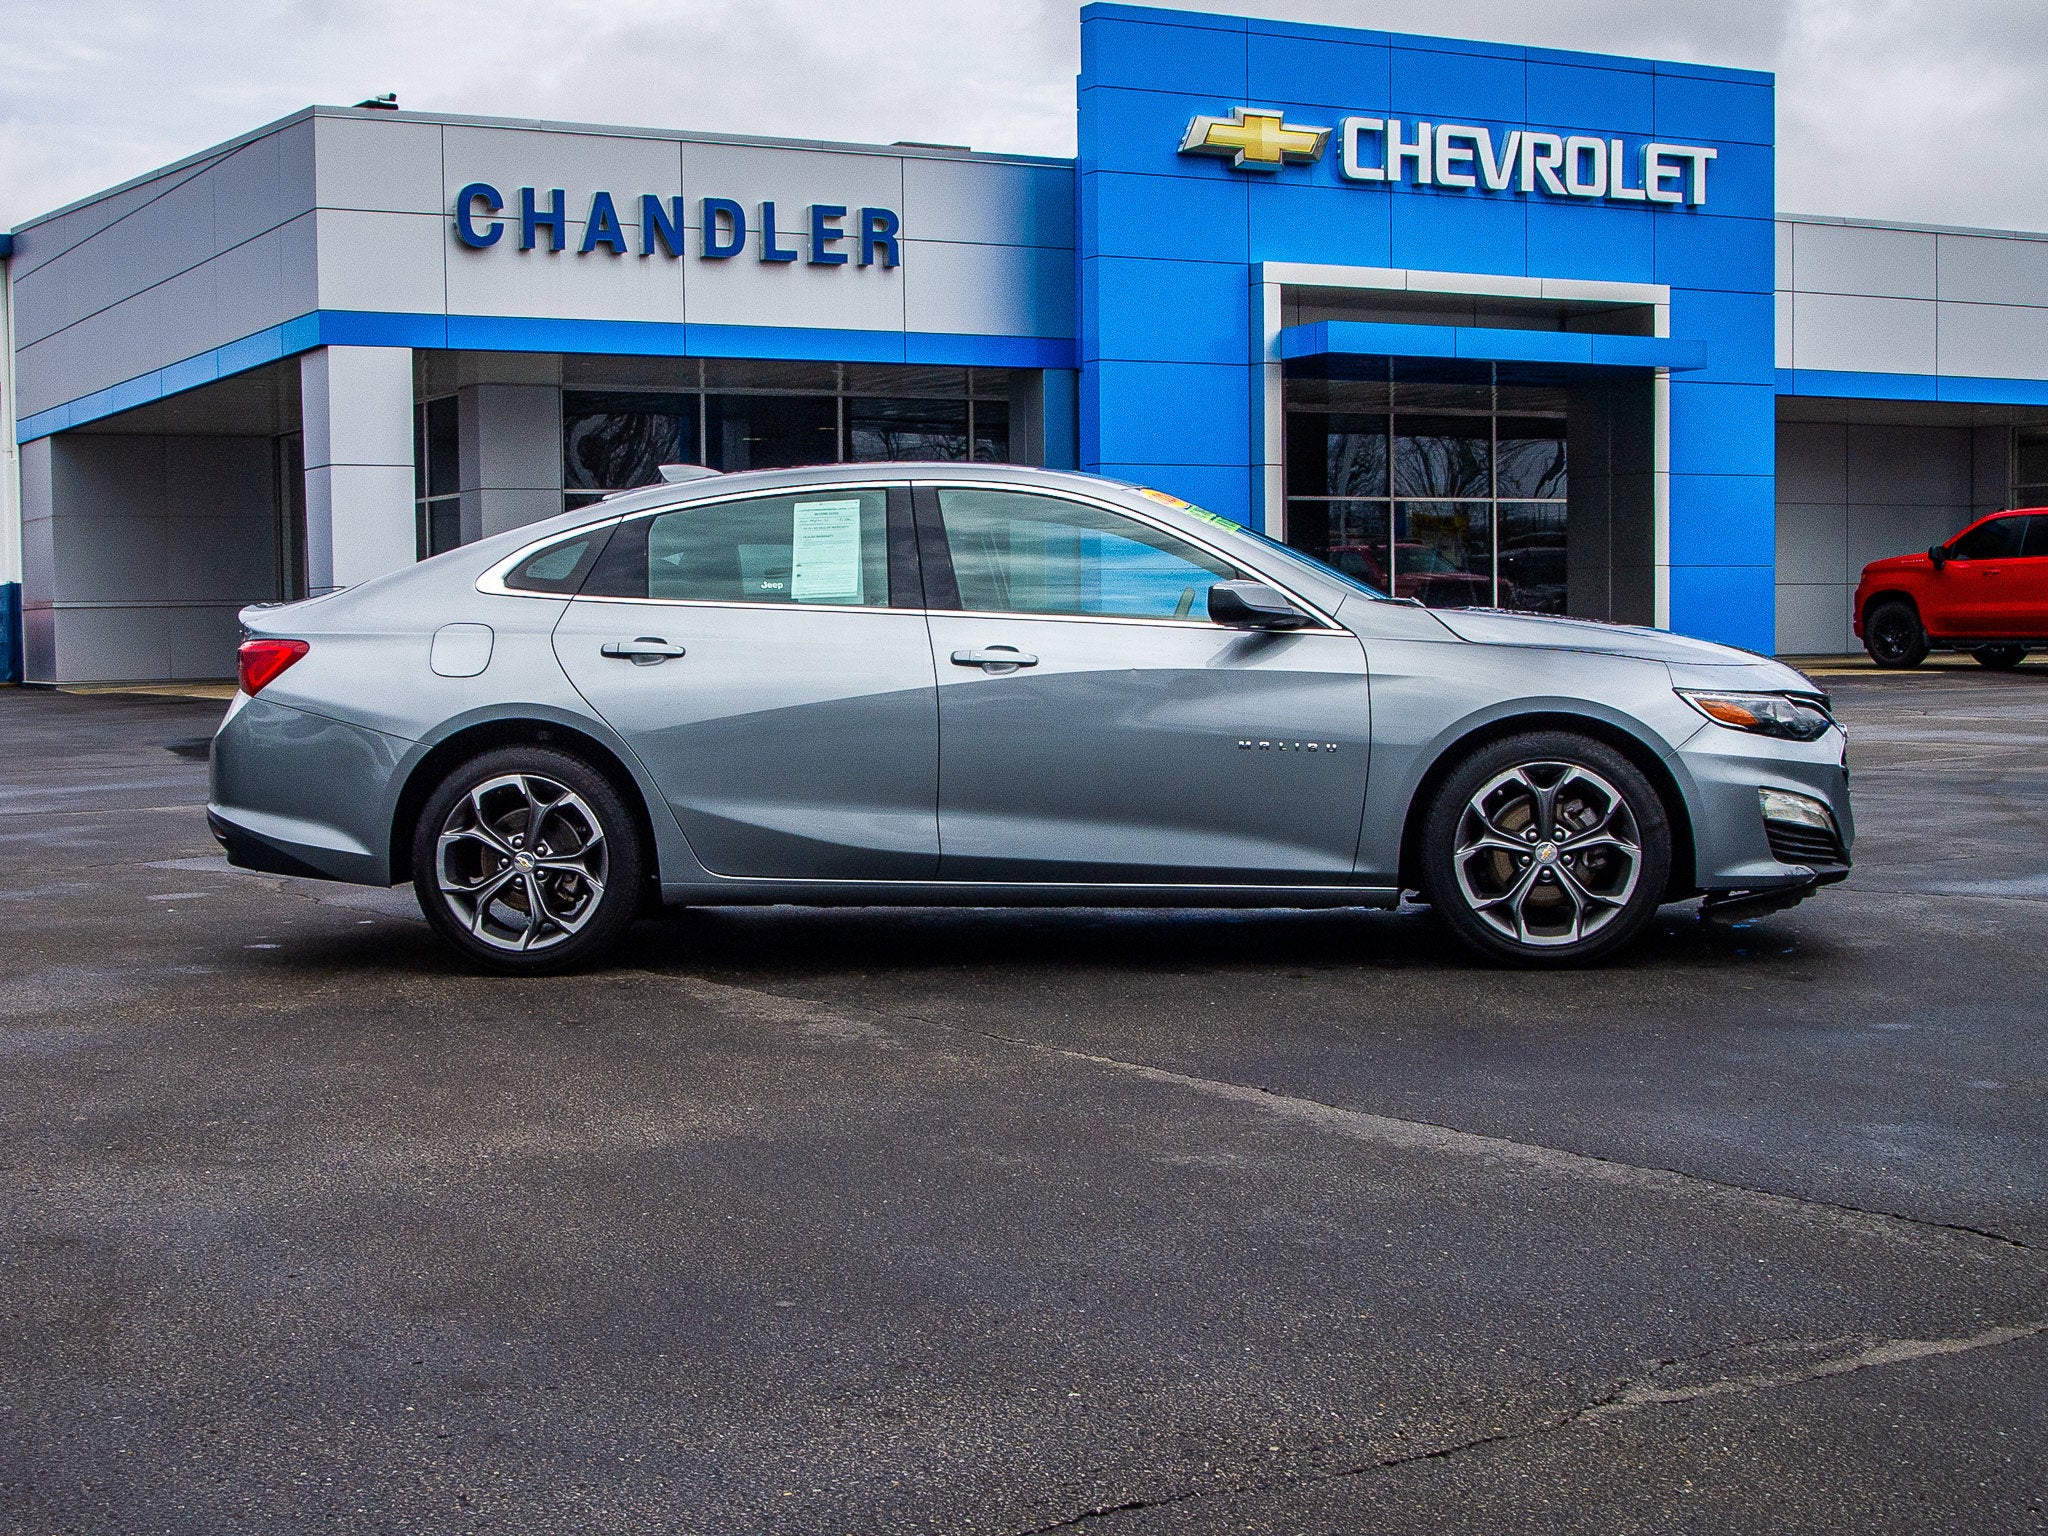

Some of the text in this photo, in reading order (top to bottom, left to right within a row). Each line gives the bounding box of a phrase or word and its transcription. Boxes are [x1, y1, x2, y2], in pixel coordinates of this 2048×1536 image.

[1338, 115, 1718, 207] CHEVROLET
[454, 182, 901, 270] CHANDLER
[760, 581, 784, 590] Jeep
